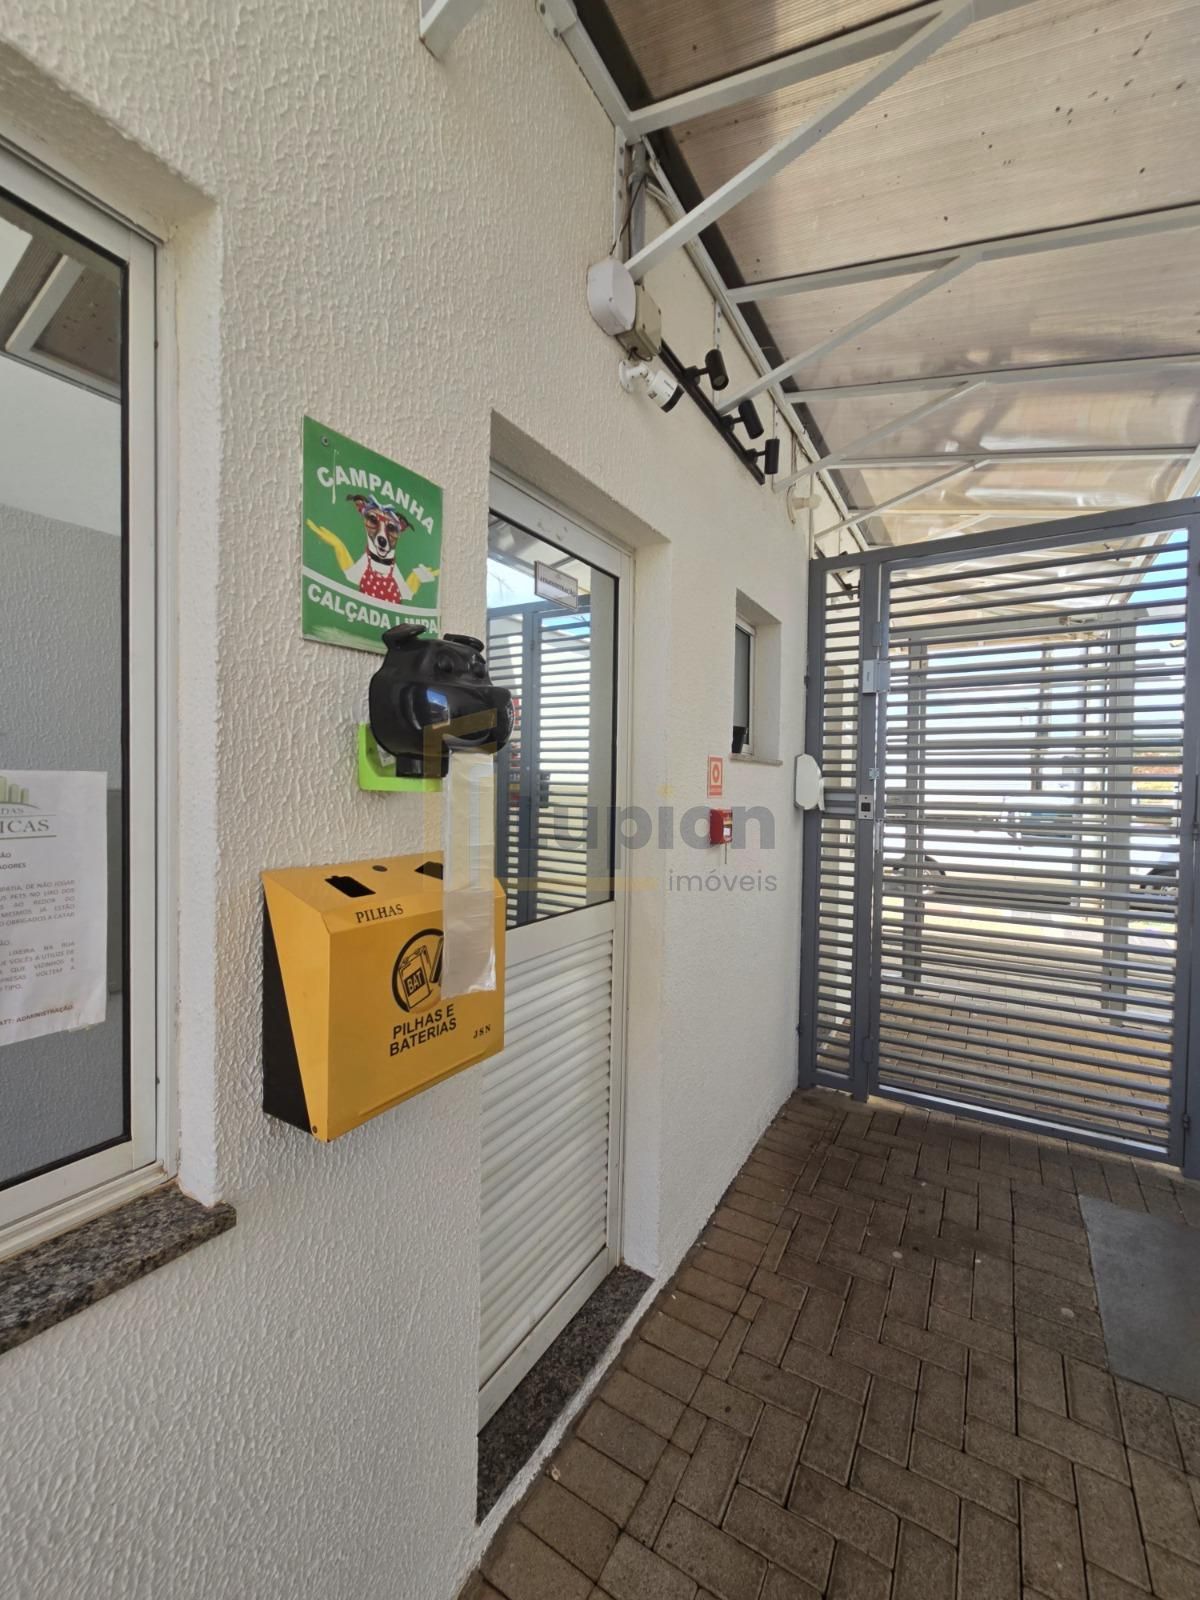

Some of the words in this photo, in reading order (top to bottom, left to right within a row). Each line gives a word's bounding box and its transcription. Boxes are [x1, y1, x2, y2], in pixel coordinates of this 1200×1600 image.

[317, 465, 435, 535] CAMPANHA
[307, 583, 392, 629] CALÇADA
[355, 903, 405, 923] PILHAS
[405, 972, 424, 993] BAT
[390, 1018, 457, 1056] BATERIAS
[393, 1006, 442, 1039] PILHAS
[446, 1004, 454, 1017] E
